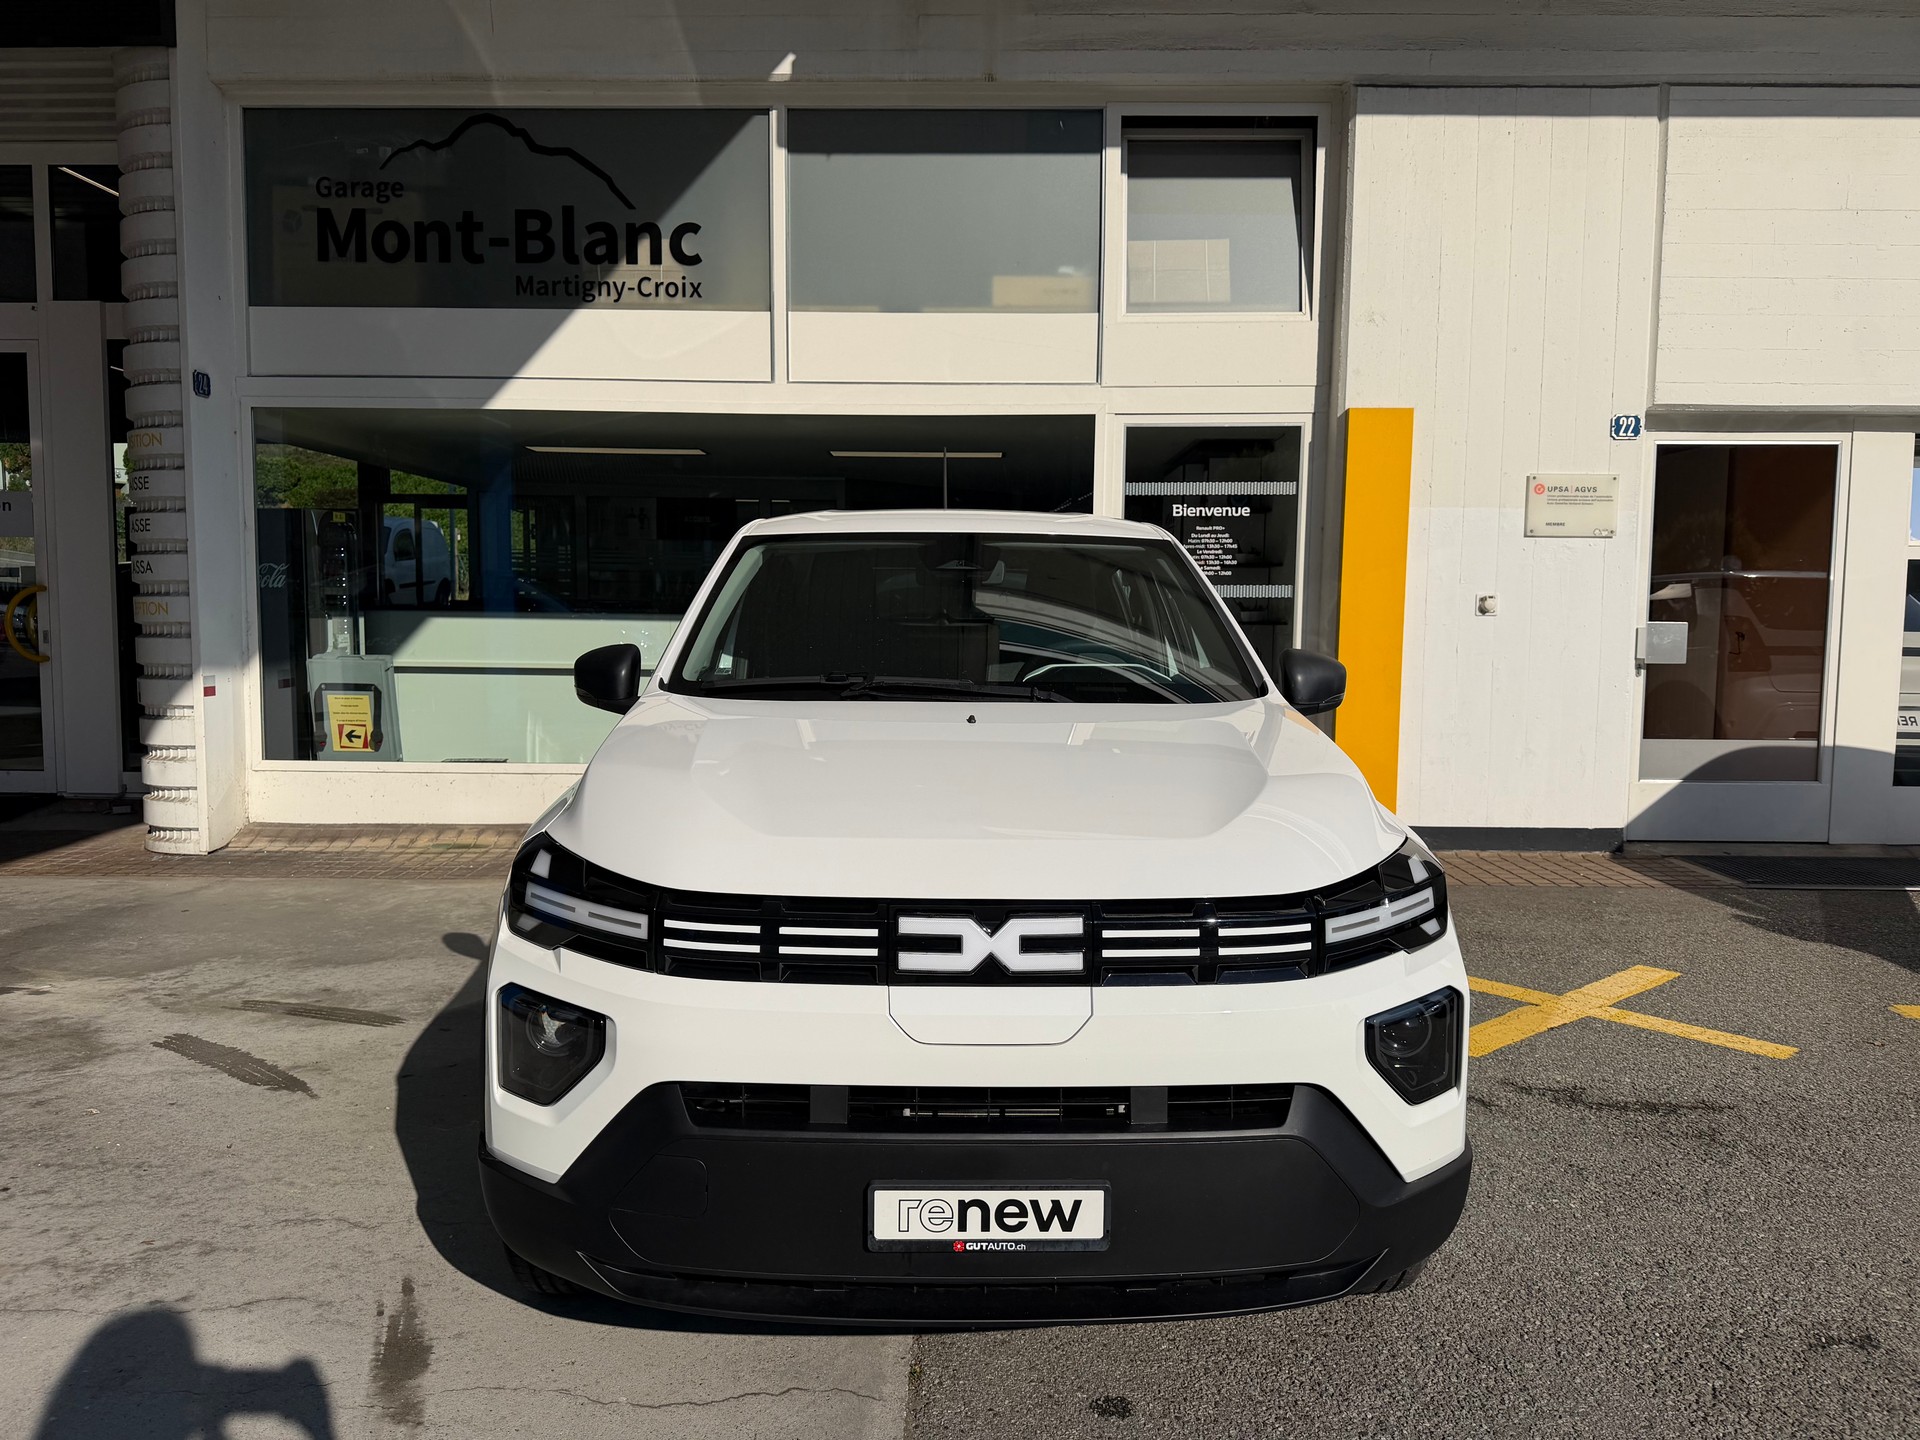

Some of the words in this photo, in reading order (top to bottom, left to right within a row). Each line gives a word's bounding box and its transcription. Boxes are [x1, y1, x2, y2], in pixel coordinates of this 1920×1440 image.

[315, 176, 404, 203] Garage
[316, 205, 703, 266] Mont-Blanc
[514, 274, 703, 303] Martigny-Croix
[1618, 416, 1636, 437] 22
[1172, 503, 1251, 517] Bienvenue
[898, 1198, 1083, 1233] renew
[965, 1242, 1027, 1251] GUTAUTO.ch
